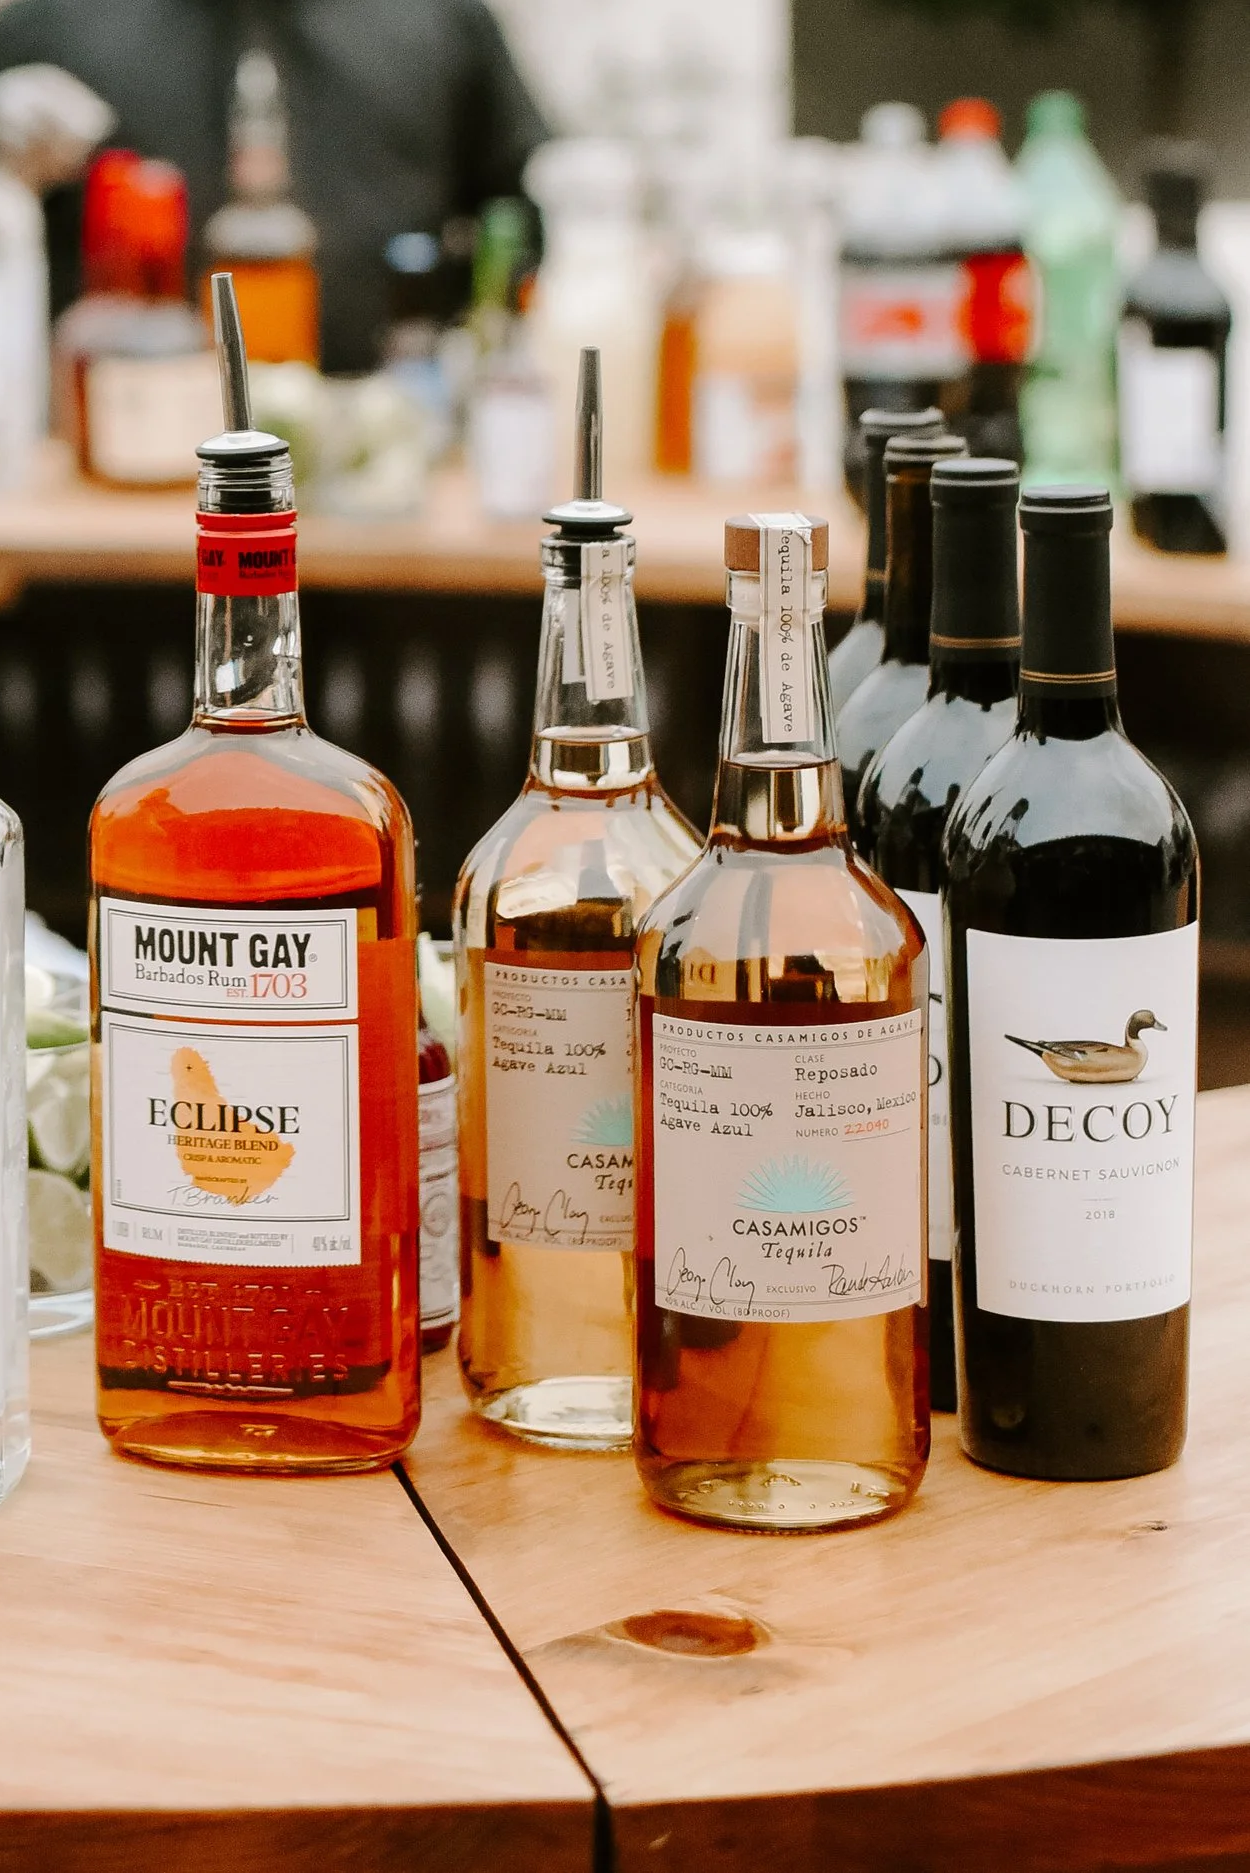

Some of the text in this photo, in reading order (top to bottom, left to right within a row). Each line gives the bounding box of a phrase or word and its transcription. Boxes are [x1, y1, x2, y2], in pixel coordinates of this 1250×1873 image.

[237, 549, 290, 568] MOUNT
[779, 605, 794, 644] 100%
[781, 652, 793, 672] de
[779, 682, 793, 733] Agave
[134, 924, 312, 969] MOUNT GAY
[134, 962, 248, 988] Barbados Rum
[226, 973, 308, 999] EST. 1703
[494, 970, 579, 986] PRODUCTOS
[662, 1018, 915, 1043] PRODUCTOS CASAMIGOS DE AGAVE
[493, 1035, 607, 1059] Tequila 100%
[795, 1054, 826, 1064] CLASE
[493, 1056, 588, 1076] Agave Azul
[794, 1062, 879, 1084] Reposado
[659, 1092, 774, 1120] Tequila 100%
[794, 1090, 918, 1119] Jalisco, Mexico
[795, 1090, 830, 1101] HECHO
[147, 1096, 300, 1135] ECLIPSE
[659, 1112, 754, 1138] Agave Azul
[1001, 1093, 1180, 1144] DECOY
[167, 1133, 279, 1152] HERITAGE BLEND
[1001, 1156, 1181, 1182] CABERNET SAUVIGNON
[731, 1216, 859, 1238] CASAMIGOS
[1085, 1209, 1117, 1221] 2018
[760, 1241, 834, 1266] Tequila
[766, 1284, 817, 1295] EXCLUSIVO
[1008, 1279, 1096, 1295] DUCKHORN
